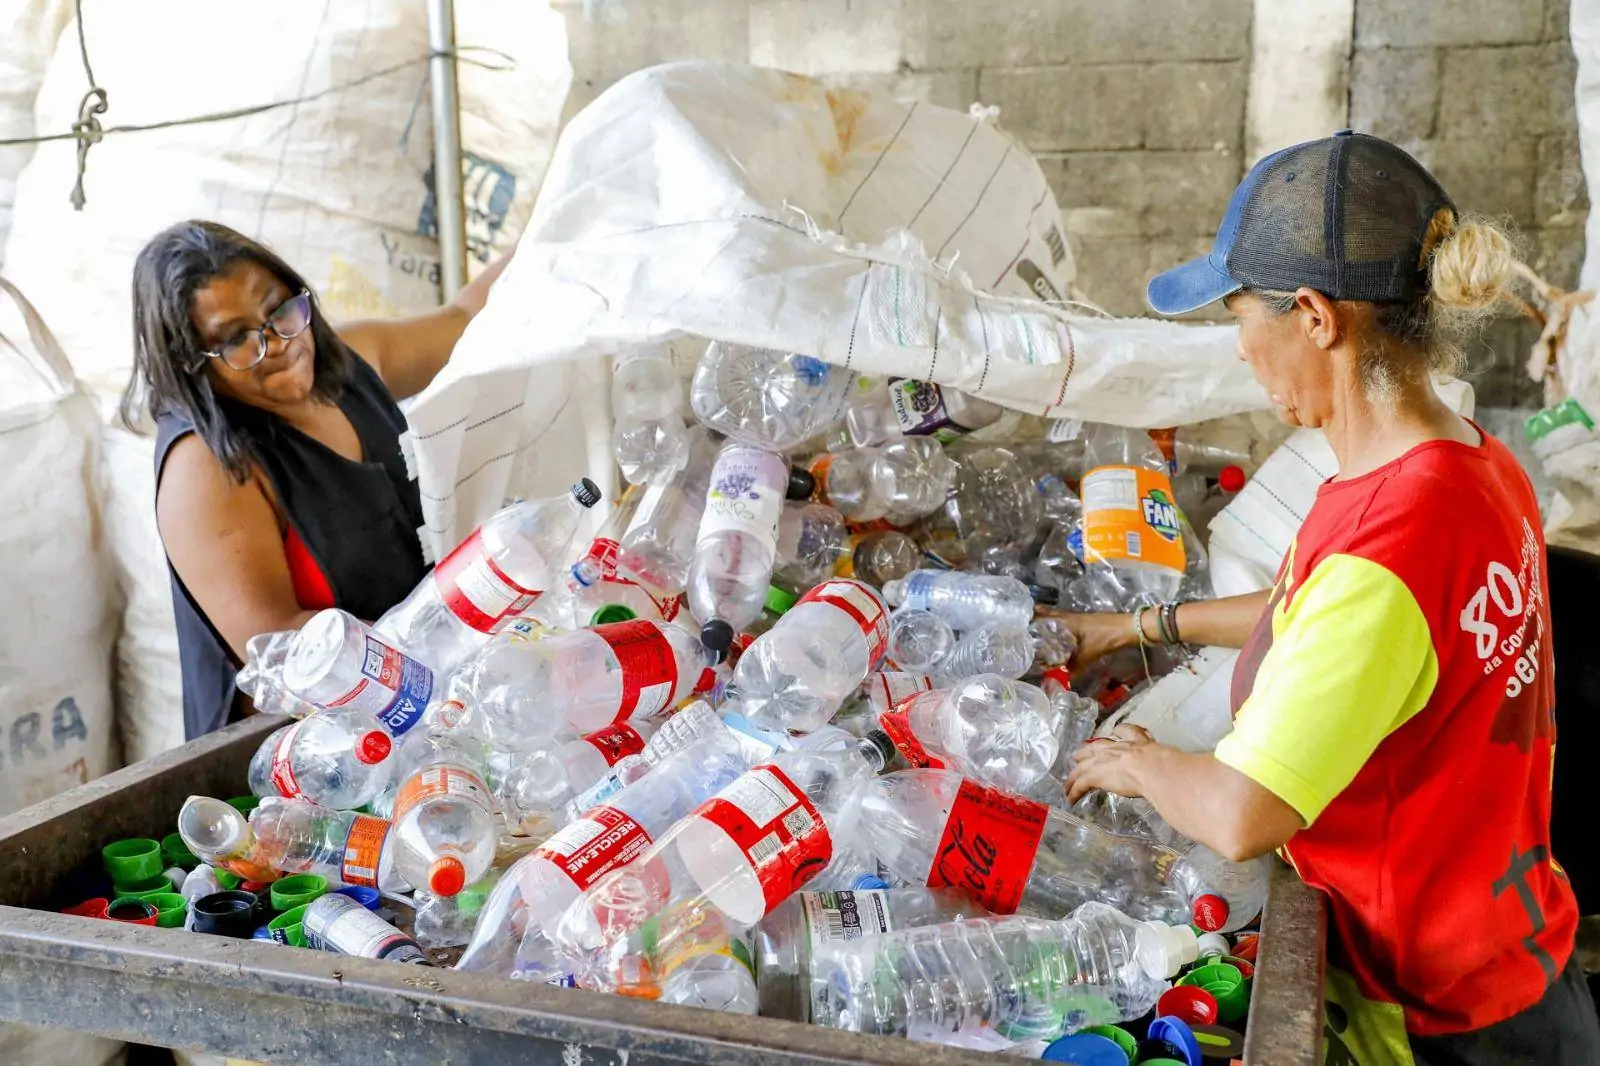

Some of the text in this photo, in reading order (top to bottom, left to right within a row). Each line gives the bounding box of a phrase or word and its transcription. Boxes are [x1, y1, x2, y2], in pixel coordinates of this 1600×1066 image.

[1141, 497, 1180, 531] FAN
[1459, 560, 1523, 660] 80
[1483, 654, 1503, 676] da
[0, 694, 88, 772] RA
[566, 820, 638, 876] RECICLE-ME
